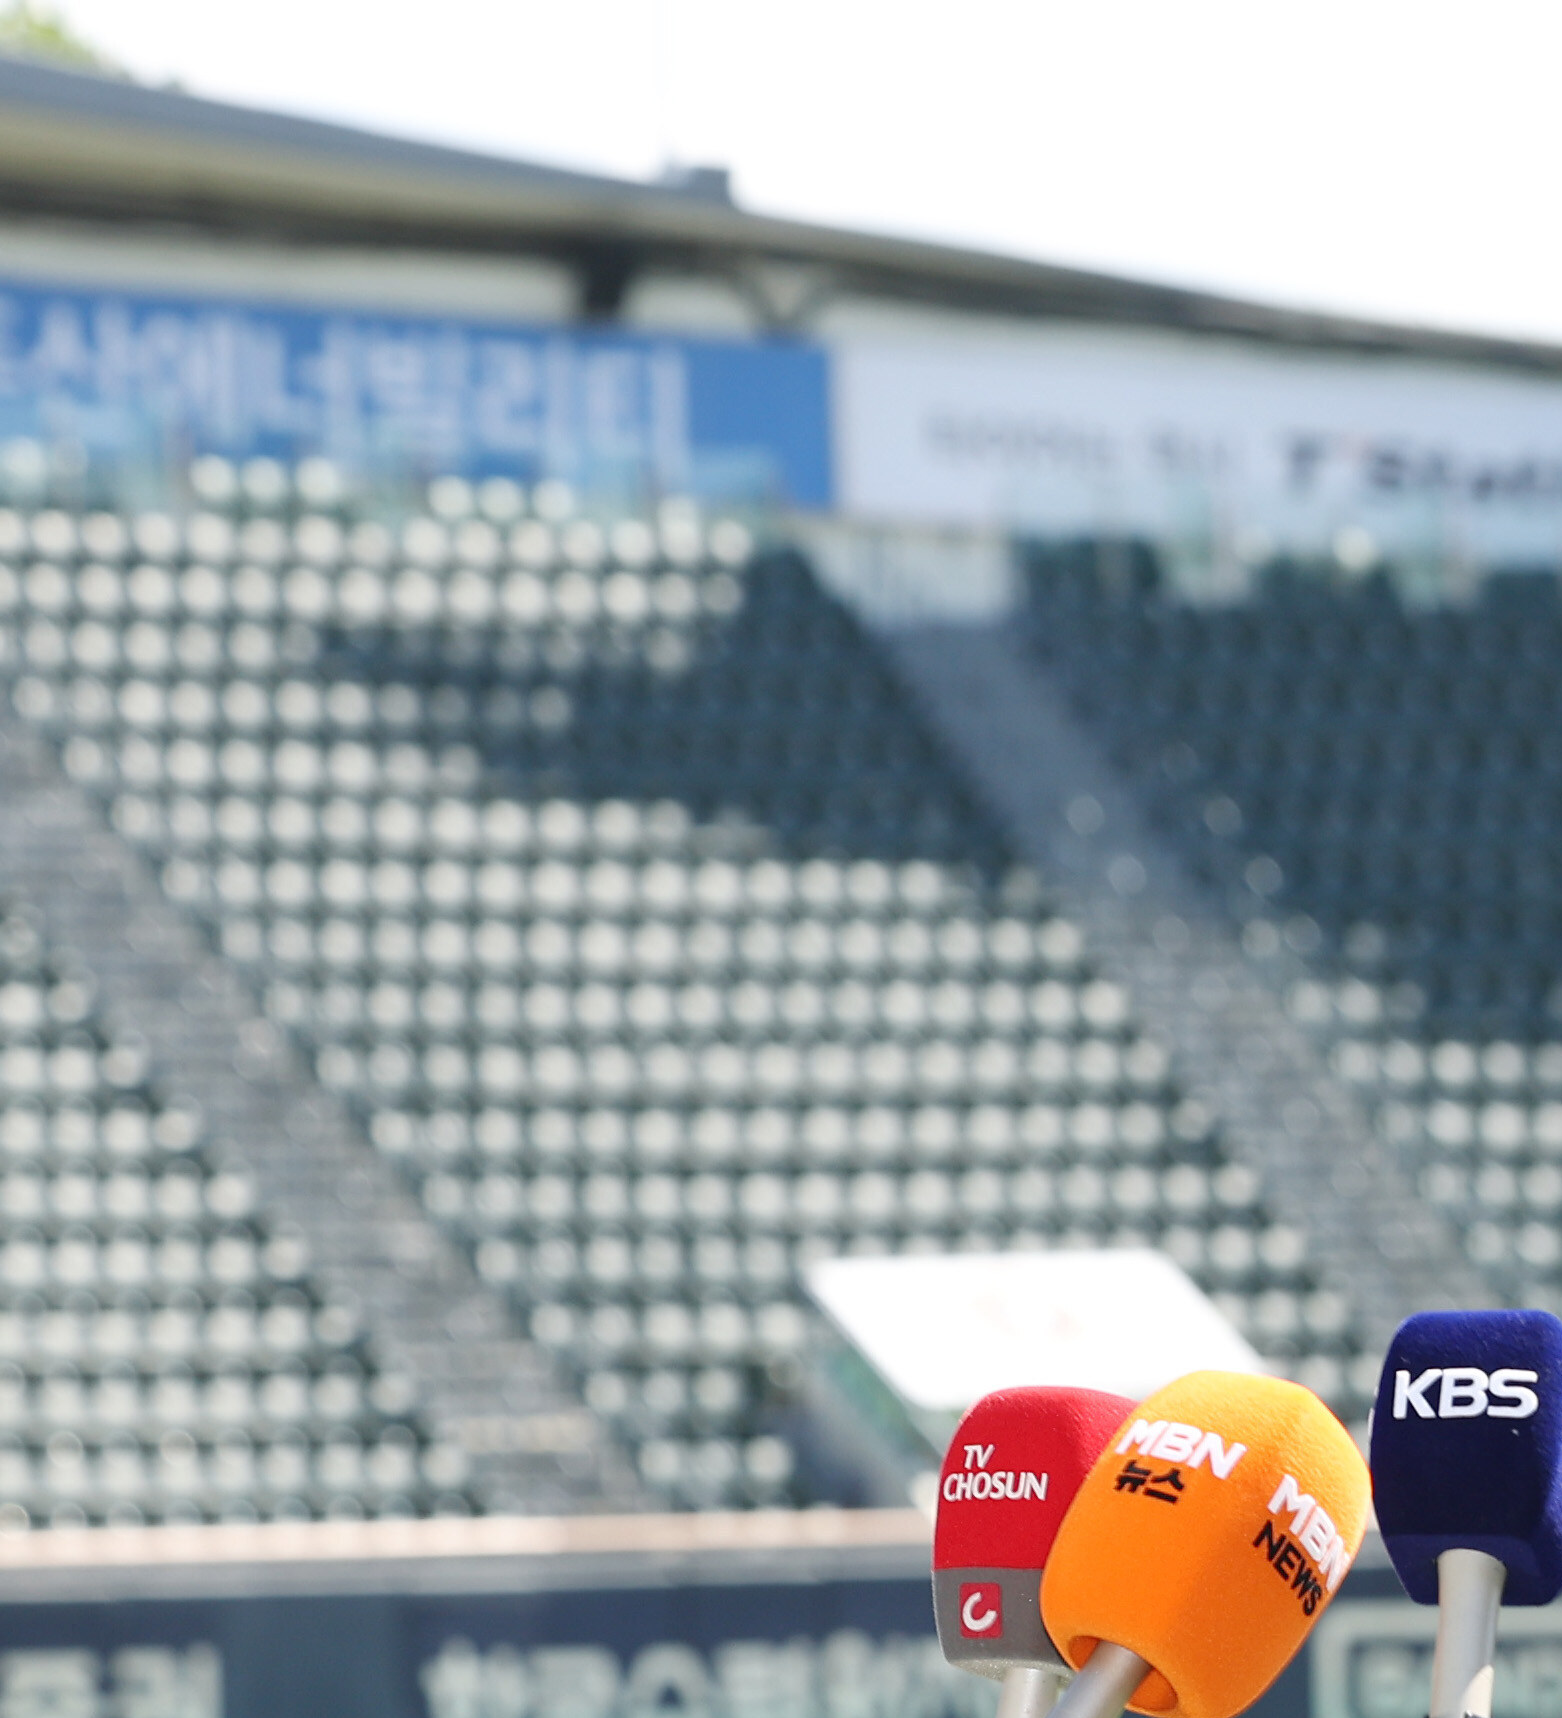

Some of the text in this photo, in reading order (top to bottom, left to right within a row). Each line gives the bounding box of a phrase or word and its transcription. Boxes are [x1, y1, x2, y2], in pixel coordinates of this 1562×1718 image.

[0, 300, 692, 482] 산에너빌리티
[1391, 1366, 1540, 1421] KBS
[963, 1443, 996, 1471] TV
[1114, 1418, 1248, 1480] MBN
[942, 1471, 1049, 1502] CHOSUN
[1113, 1459, 1185, 1505] 뉴스
[1266, 1473, 1351, 1593] MBN
[1252, 1518, 1322, 1617] NEWS
